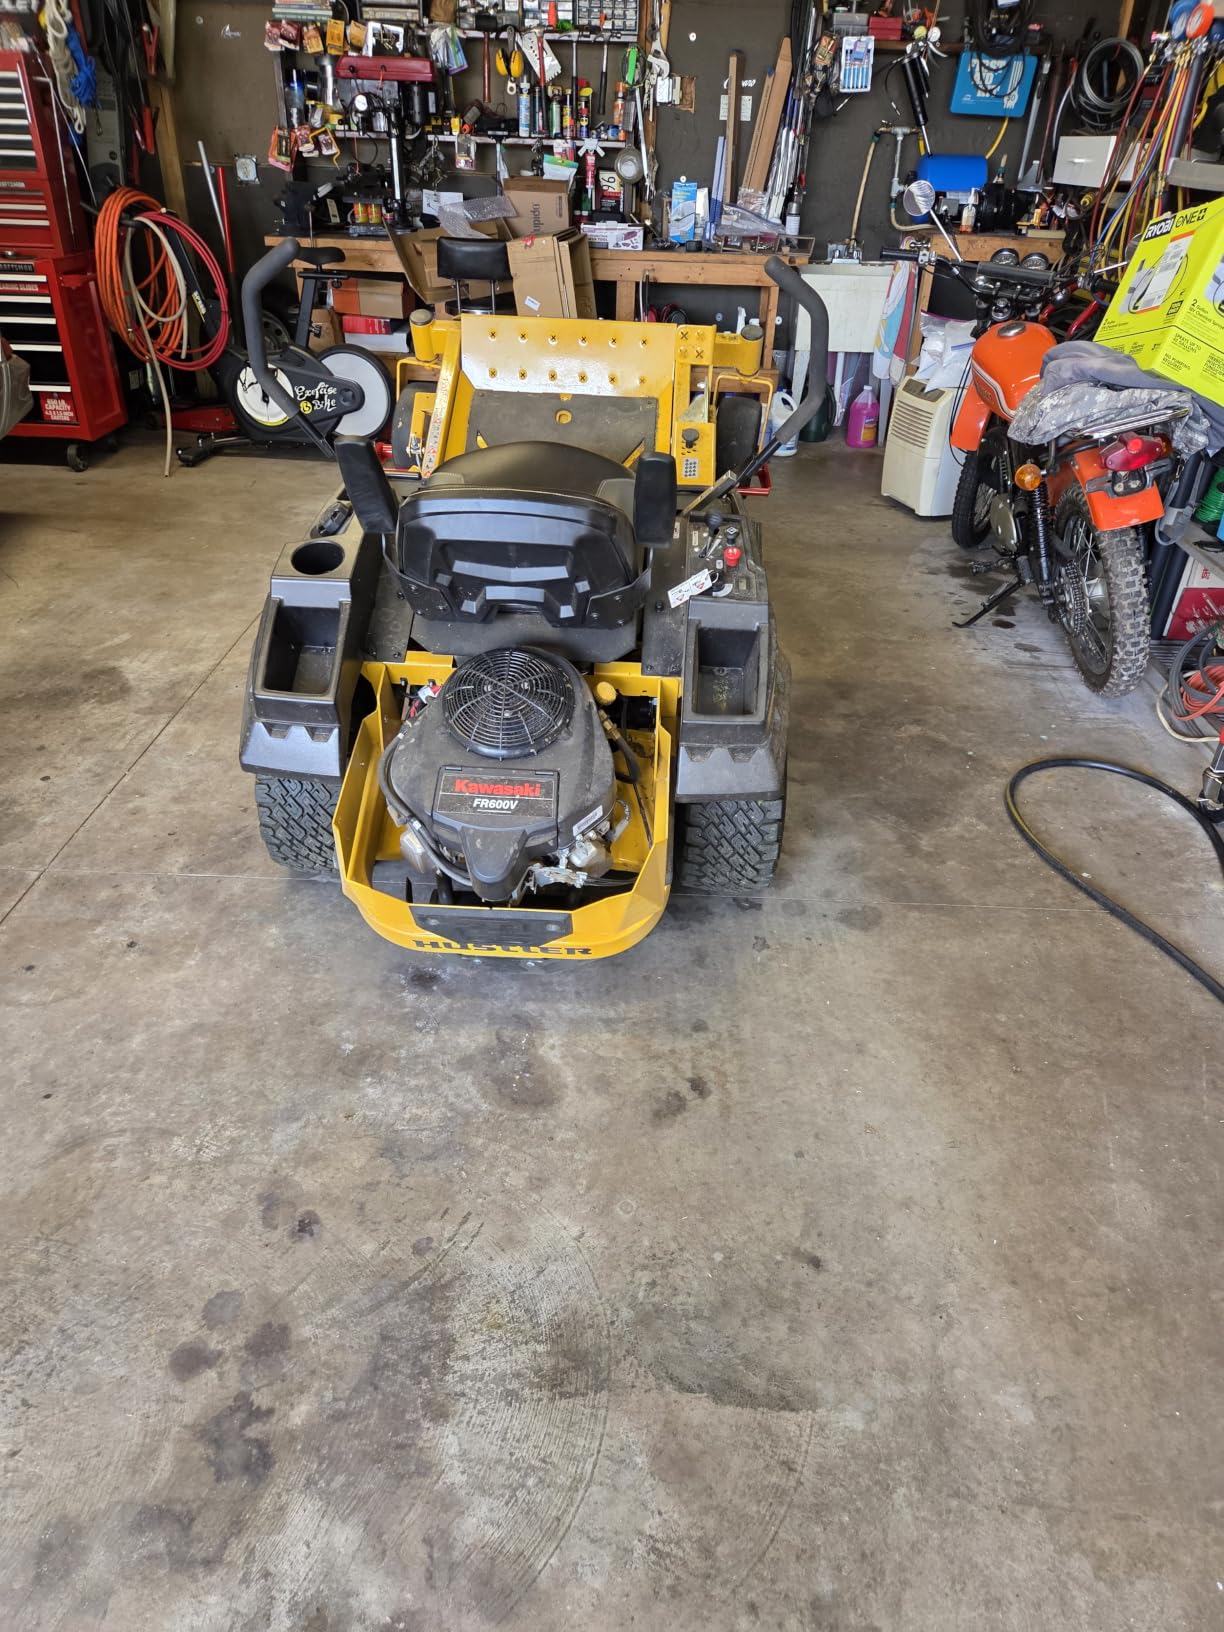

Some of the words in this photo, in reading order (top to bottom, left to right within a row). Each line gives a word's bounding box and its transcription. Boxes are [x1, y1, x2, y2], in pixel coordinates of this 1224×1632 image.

[1145, 218, 1174, 239] RYOBI
[294, 381, 338, 401] Exercise
[312, 394, 337, 412] Bike
[454, 778, 541, 797] Kawasaki
[472, 798, 519, 810] FR600V
[412, 939, 593, 955] HUSTLER
